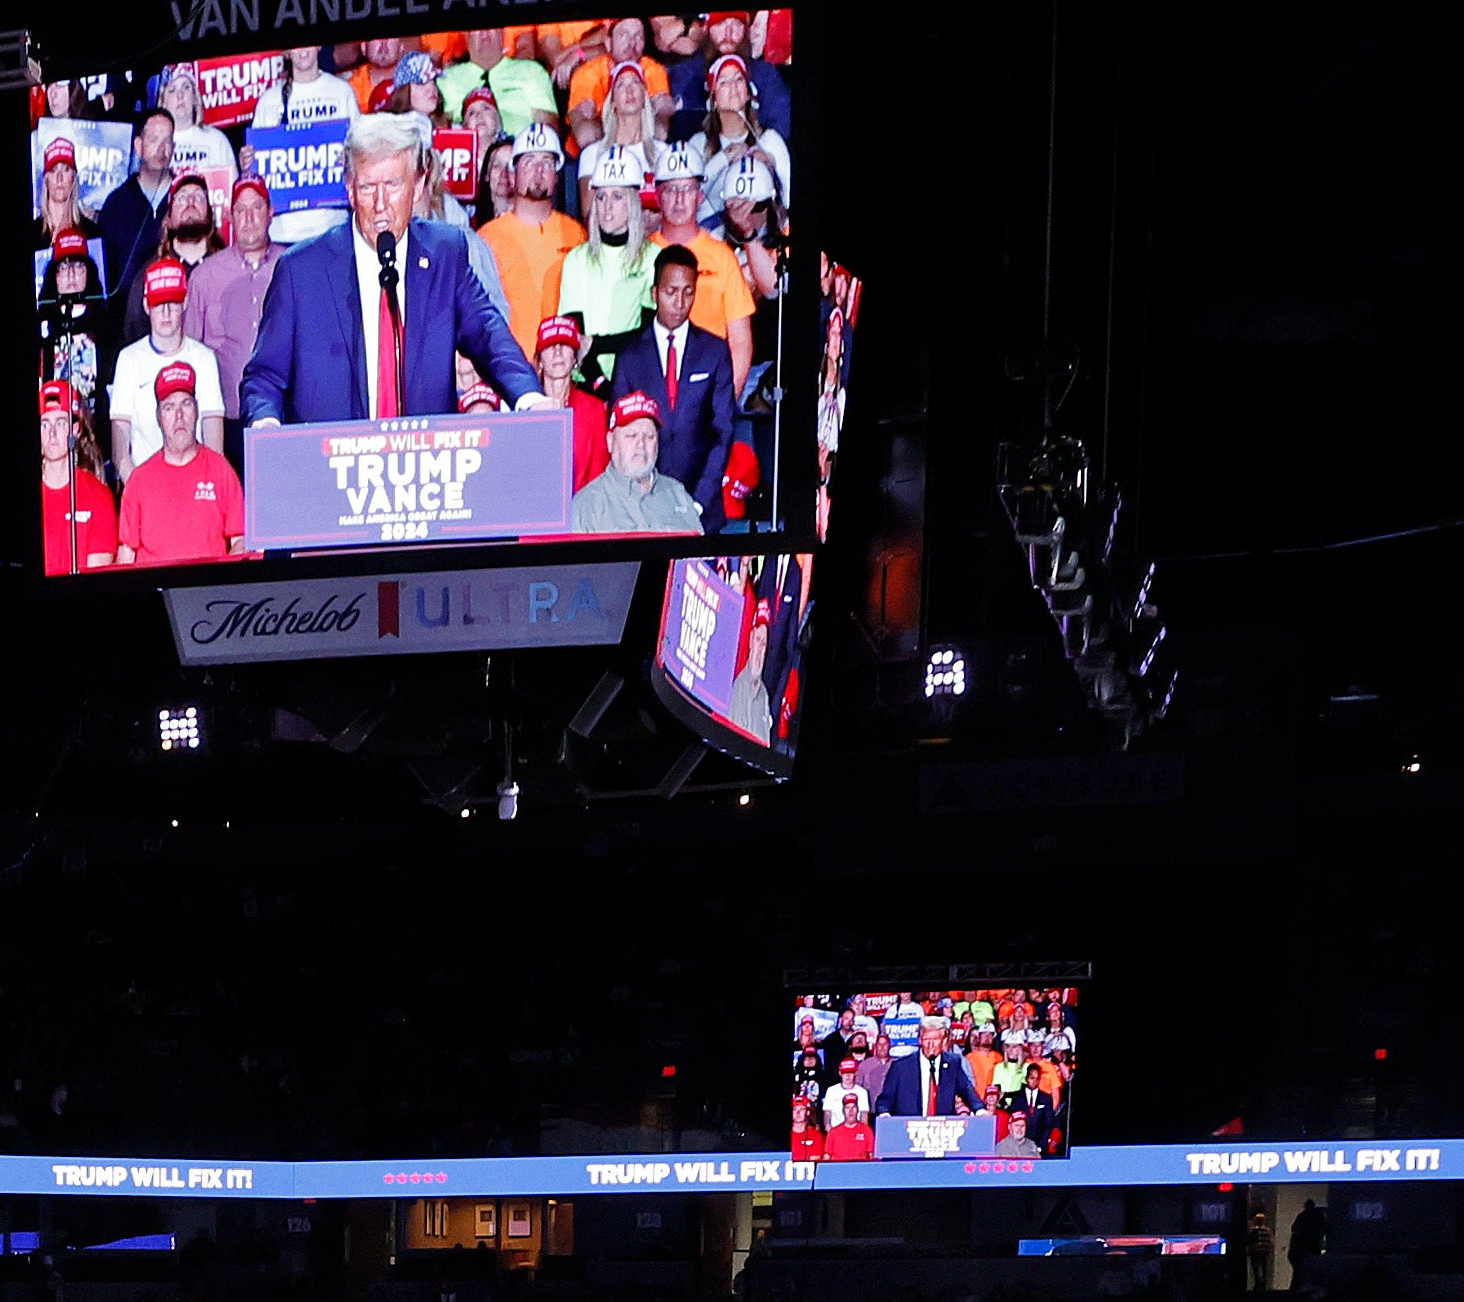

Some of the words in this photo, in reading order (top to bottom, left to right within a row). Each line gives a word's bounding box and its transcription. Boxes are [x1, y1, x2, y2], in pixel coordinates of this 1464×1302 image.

[173, 0, 260, 41] VAN
[290, 104, 338, 120] RUMP
[527, 132, 546, 148] NO
[77, 144, 123, 170] UMP
[173, 151, 208, 164] UMP
[667, 154, 688, 171] ON
[602, 163, 626, 180] TAX
[735, 176, 756, 195] OT
[330, 437, 386, 456] TRUMP
[390, 434, 431, 452] WILL
[435, 432, 461, 450] FIX
[465, 430, 481, 448] IT
[329, 448, 482, 489] TRUMP
[346, 482, 464, 514] VANCE
[366, 512, 406, 525] AMERICA
[408, 510, 437, 522] GREAT
[381, 522, 428, 541] 2024
[191, 593, 367, 644] Michelob
[416, 577, 602, 628] ULTRA
[681, 583, 716, 642] TRUMP
[587, 1164, 673, 1185] TRUMP
[677, 1163, 742, 1184] WILL
[746, 1162, 782, 1183] FIX
[786, 1161, 817, 1182] IT!
[1187, 1150, 1278, 1174] TRUMP
[1284, 1150, 1353, 1173] WILL
[1357, 1149, 1401, 1172] FIX
[1407, 1148, 1441, 1171] IT!
[53, 1165, 127, 1187] TRUMP
[131, 1166, 185, 1188] WILL
[189, 1167, 223, 1189] FIX
[226, 1168, 253, 1190] IT!
